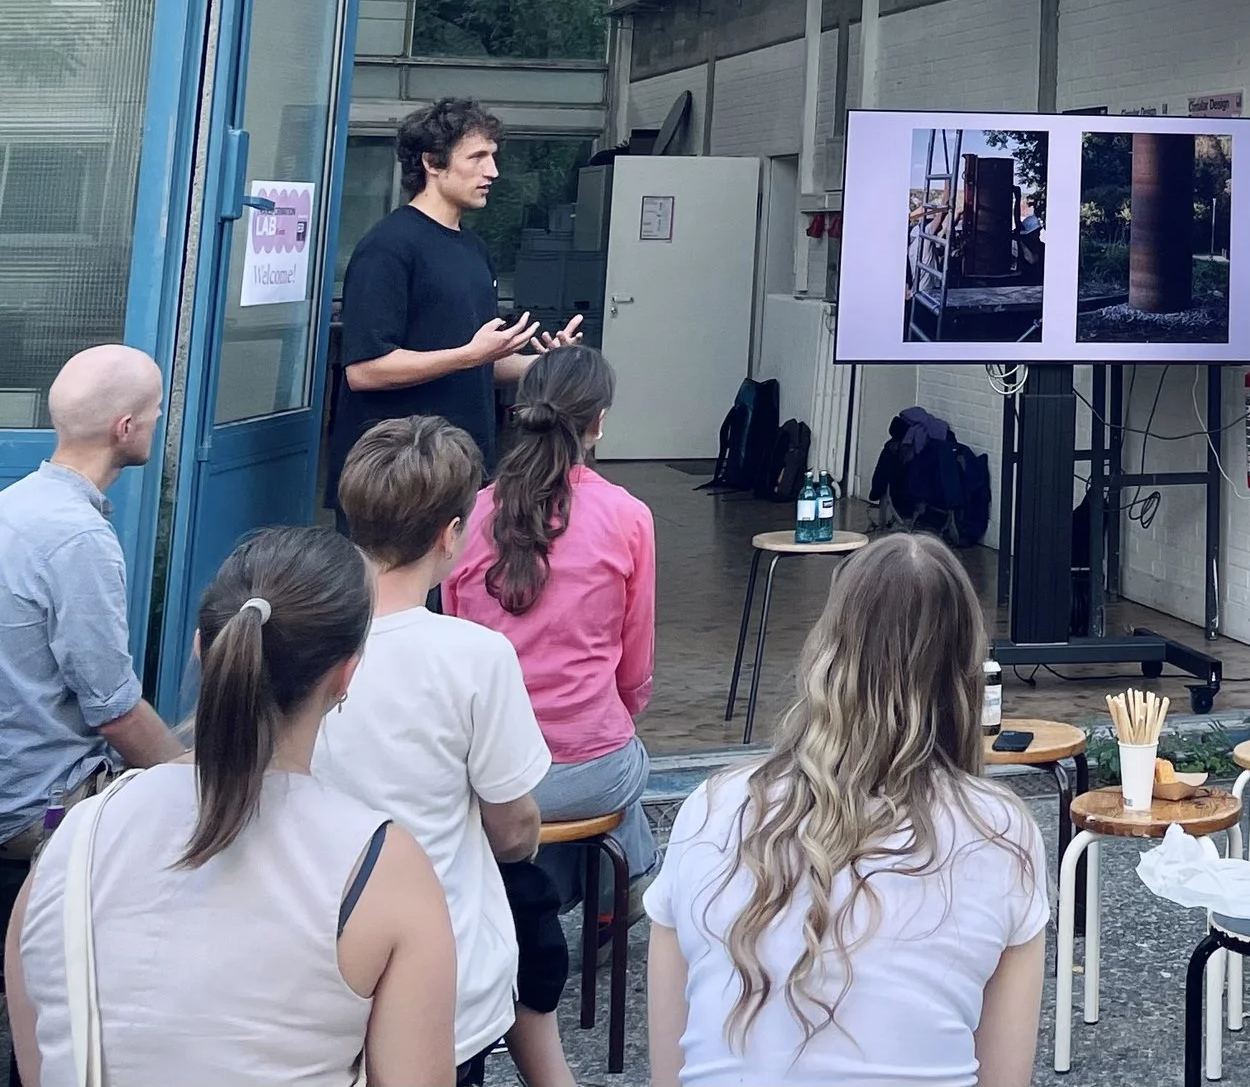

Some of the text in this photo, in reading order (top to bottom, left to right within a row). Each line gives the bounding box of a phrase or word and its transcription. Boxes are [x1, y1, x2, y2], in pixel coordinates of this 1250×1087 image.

[1209, 97, 1230, 112] Design
[256, 216, 276, 236] LAB
[254, 264, 296, 285] Welcome!
